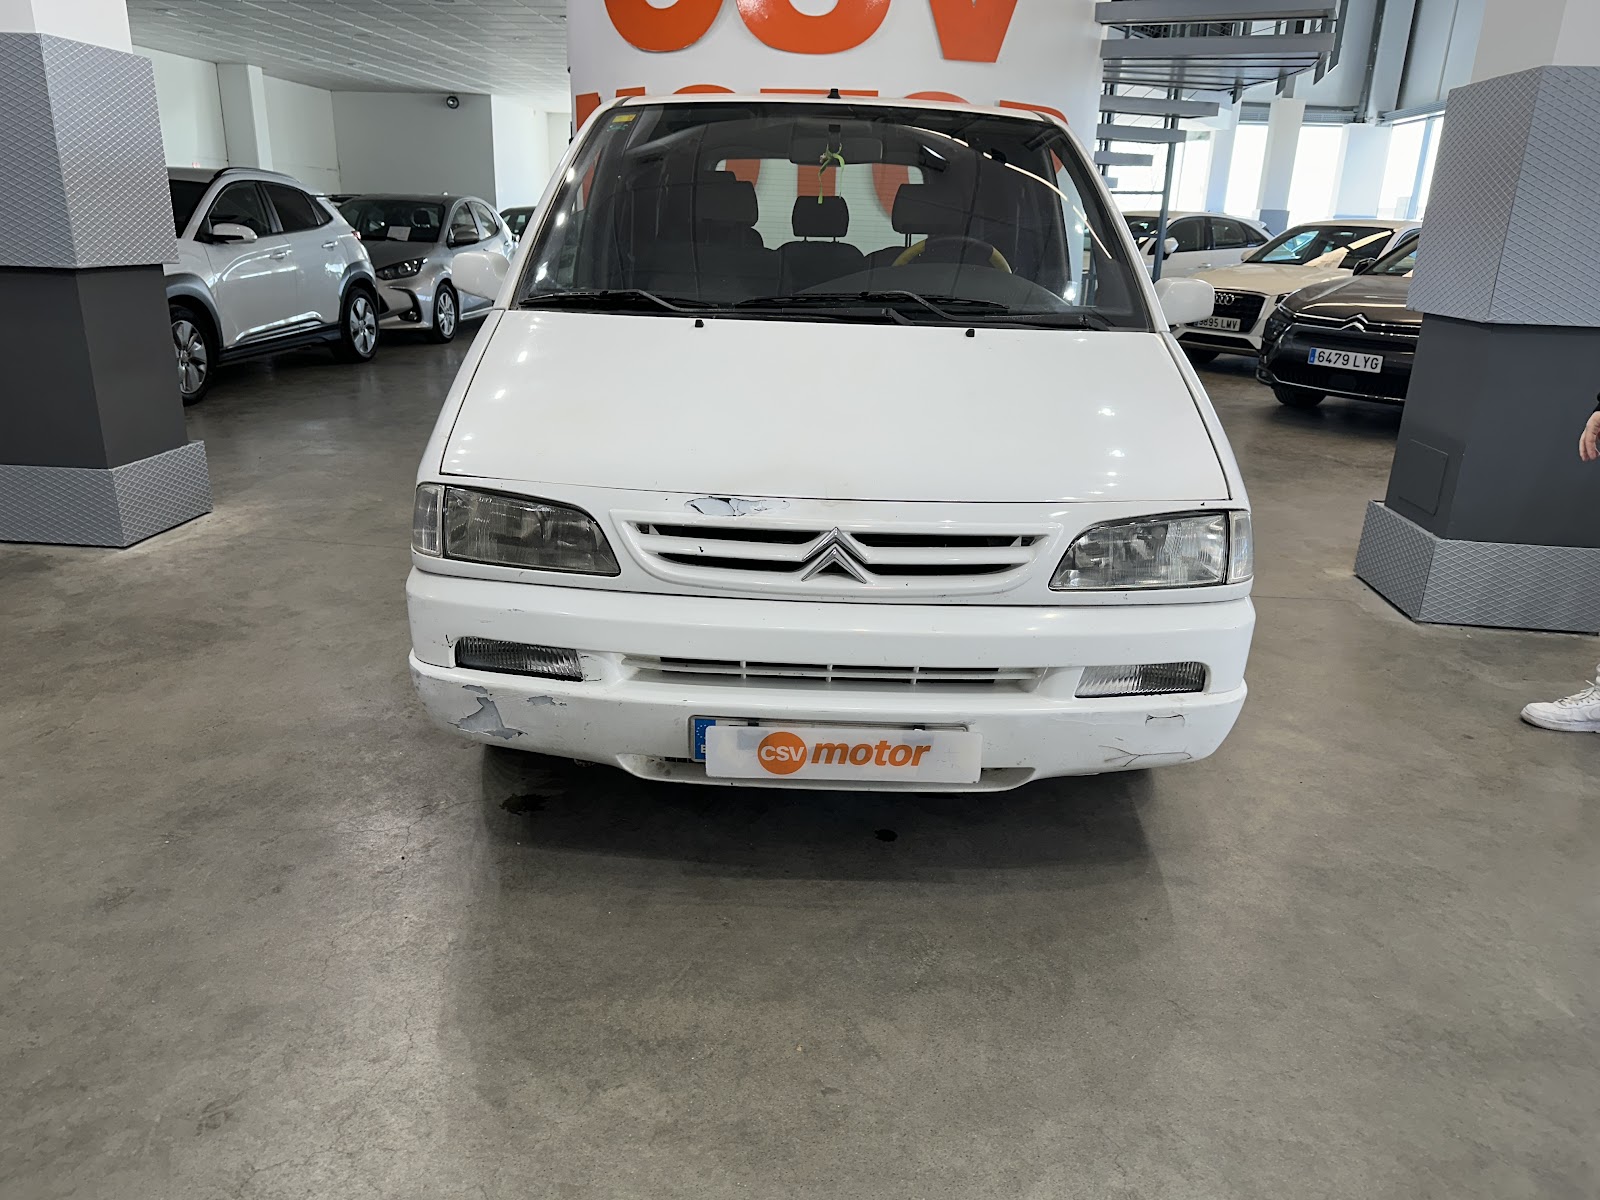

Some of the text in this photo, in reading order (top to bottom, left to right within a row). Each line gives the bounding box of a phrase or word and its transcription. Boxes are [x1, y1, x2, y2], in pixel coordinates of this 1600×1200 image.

[1220, 319, 1238, 330] LMV
[1317, 350, 1350, 366] 6479
[1352, 355, 1380, 370] LYG
[811, 740, 931, 767] motor
